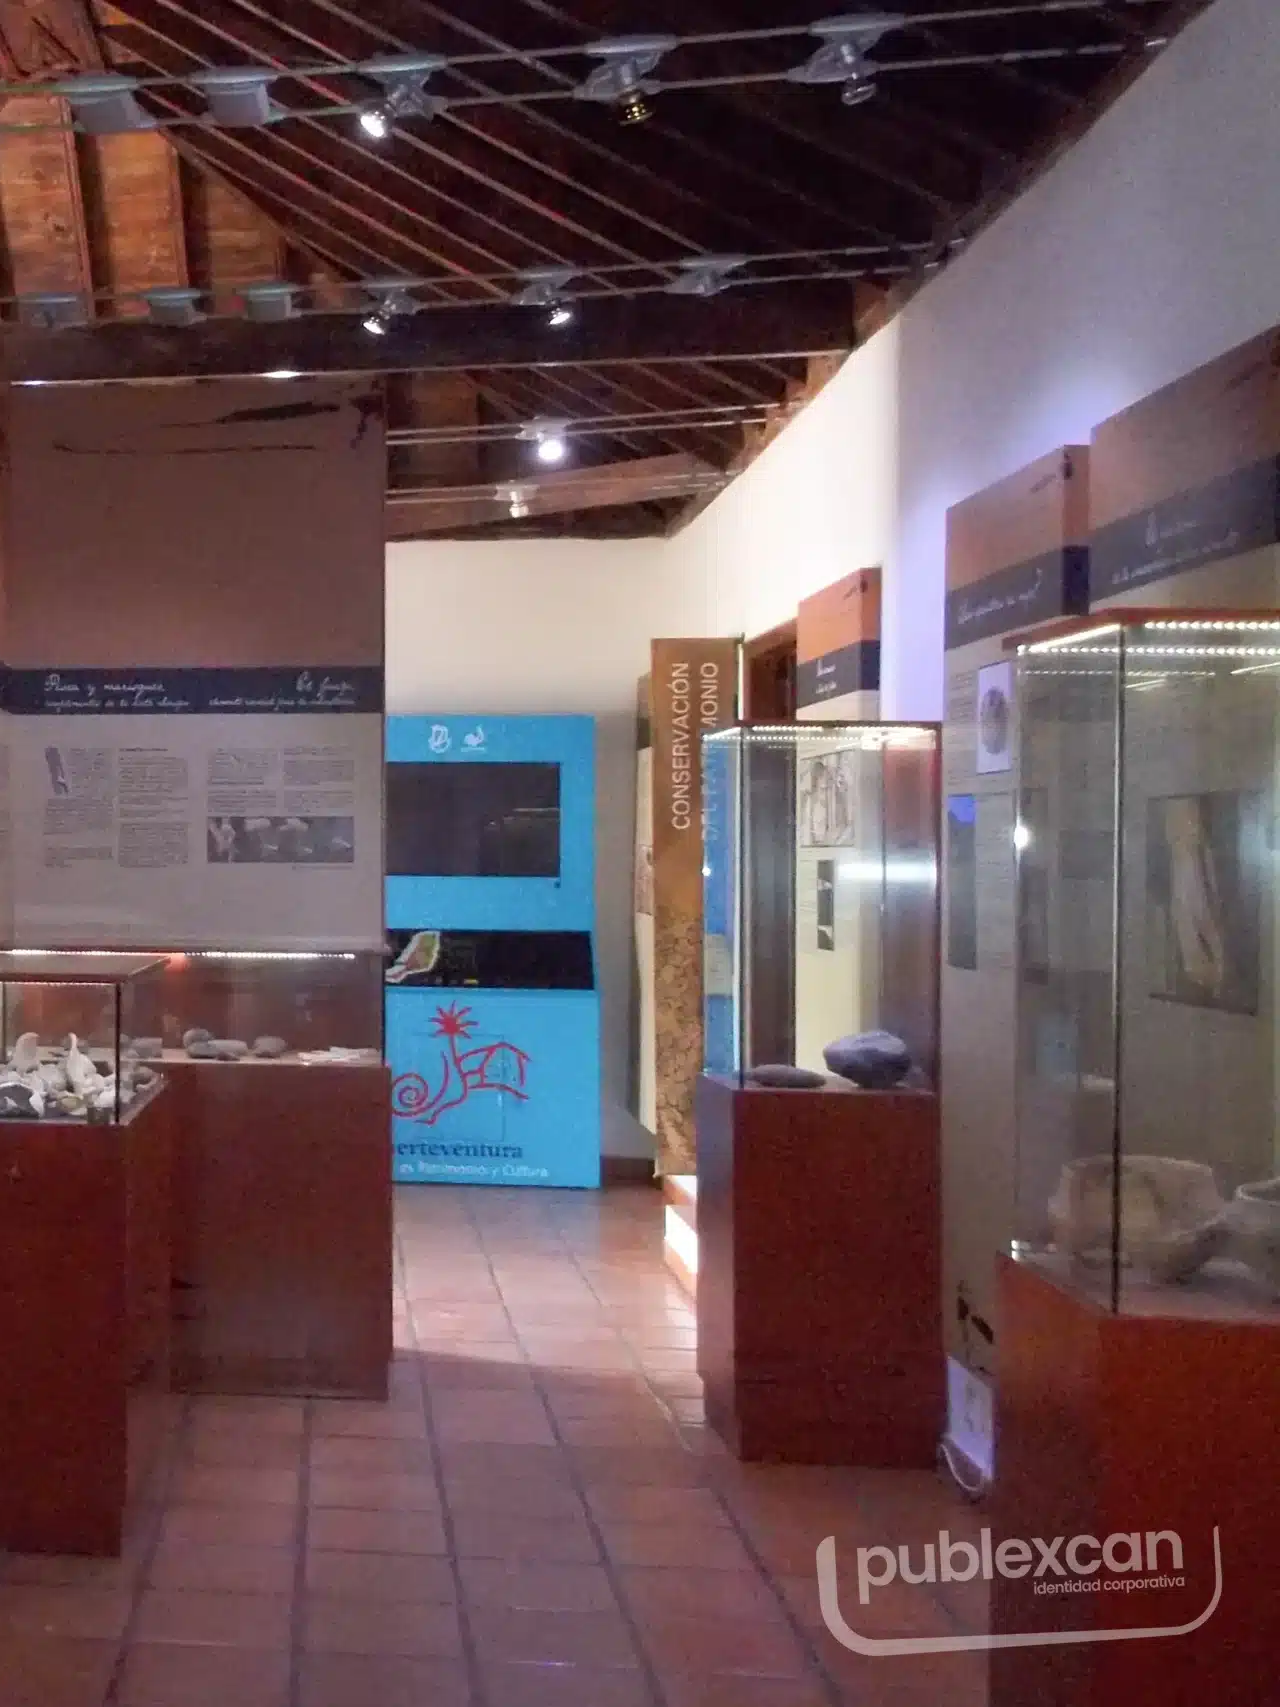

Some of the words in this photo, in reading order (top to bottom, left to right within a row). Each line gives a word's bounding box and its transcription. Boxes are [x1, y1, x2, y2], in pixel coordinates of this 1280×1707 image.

[666, 662, 691, 830] CONSERVACIÓN
[395, 1141, 523, 1159] erteventura
[502, 1163, 550, 1178] Cultura
